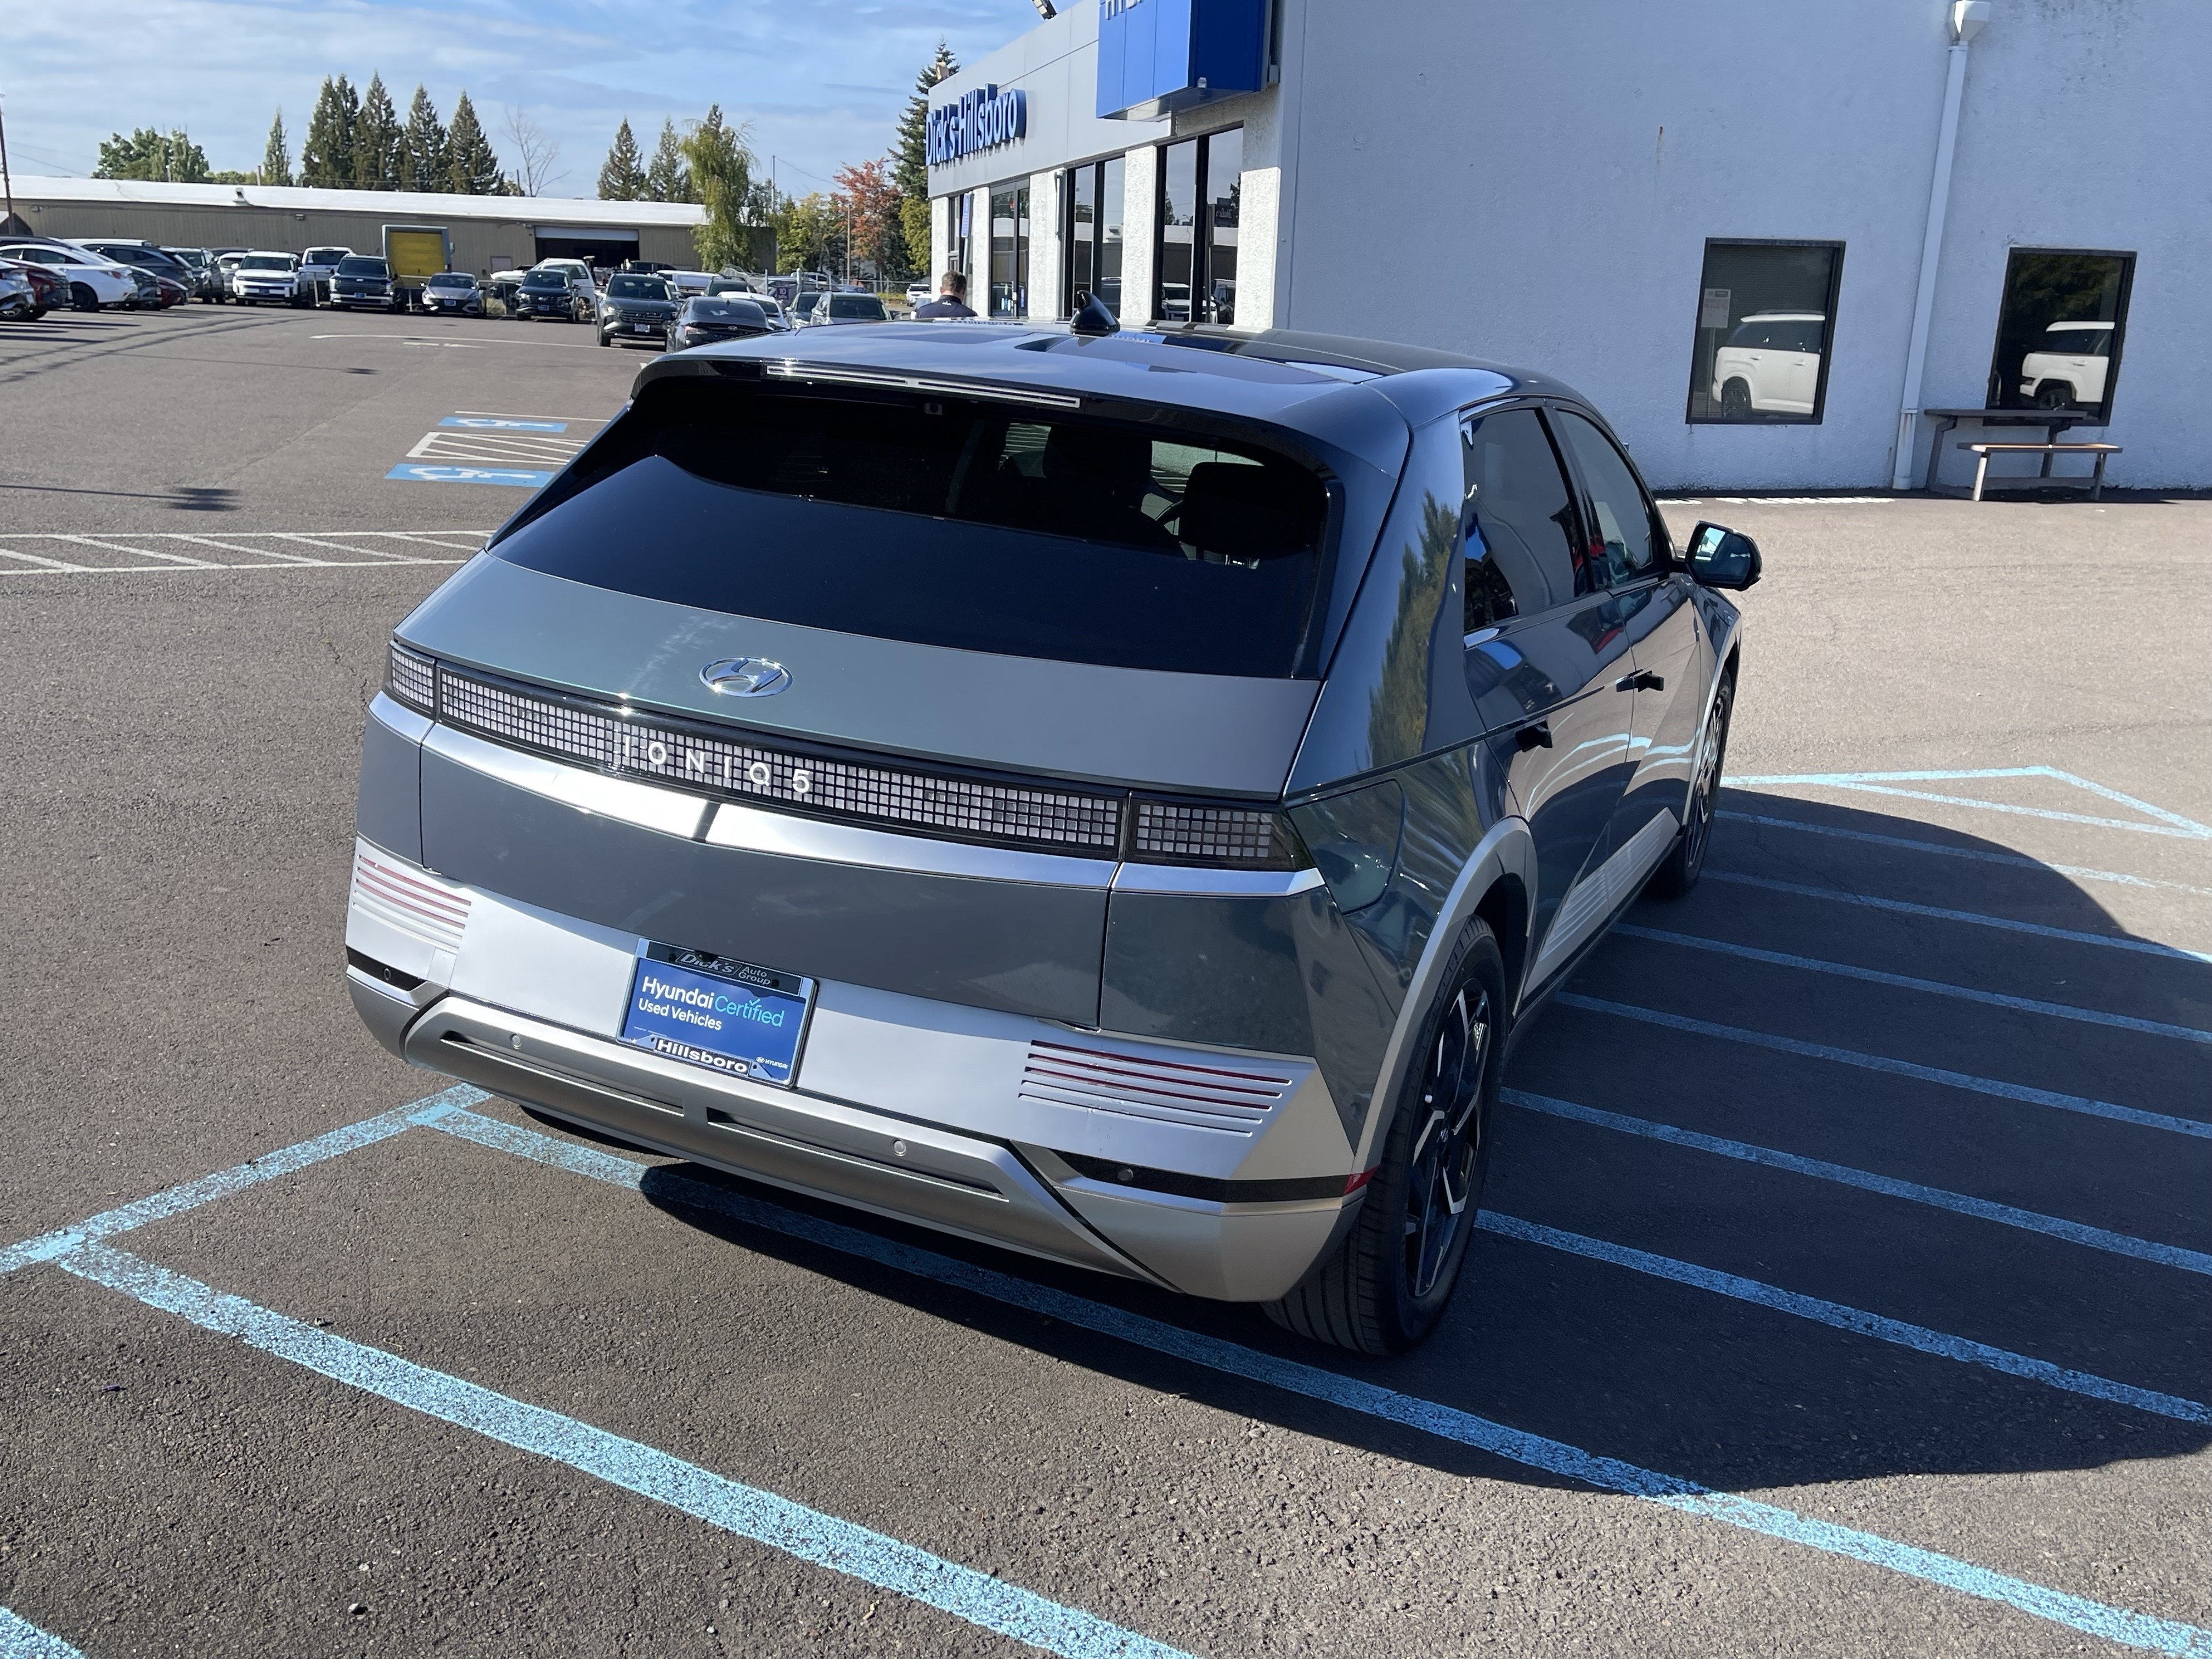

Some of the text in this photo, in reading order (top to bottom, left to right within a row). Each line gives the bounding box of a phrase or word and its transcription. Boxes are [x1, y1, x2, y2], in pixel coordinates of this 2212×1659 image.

[926, 83, 1027, 166] Dick's Hillsboro
[624, 735, 810, 793] IONIQ 5
[738, 972, 771, 985] Group
[742, 966, 768, 978] Auto
[638, 997, 722, 1031] Used Vehicles
[641, 976, 785, 1027] Hyundai Certified
[657, 1039, 748, 1074] Hillsboro
[765, 1059, 788, 1069] HYUNDAI
